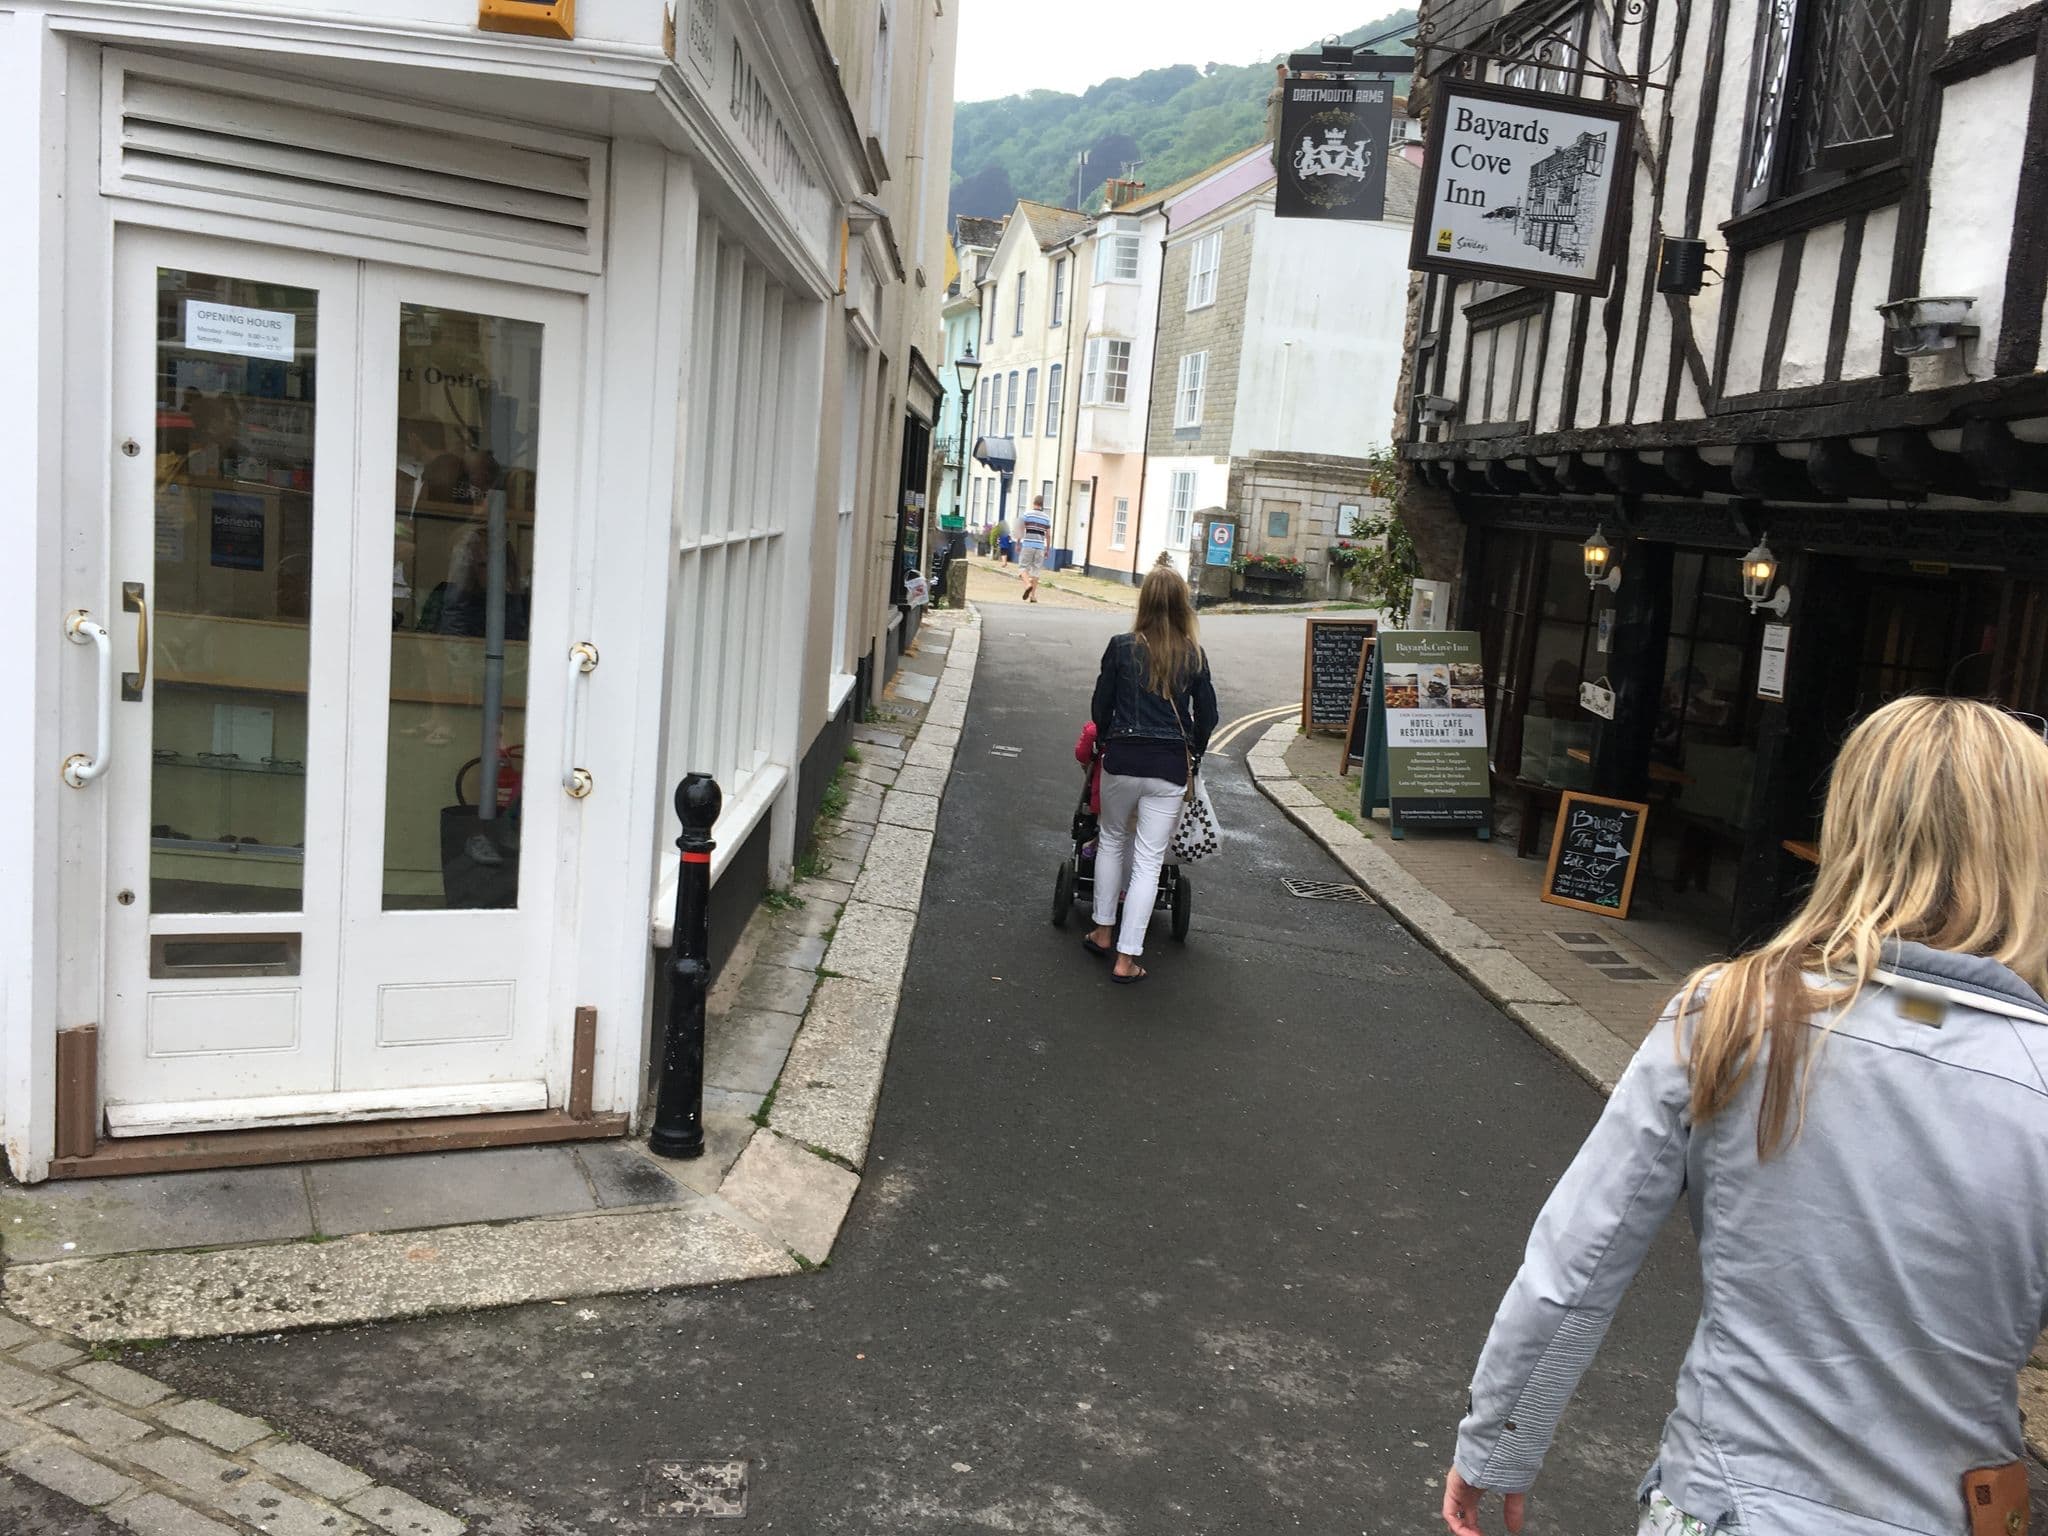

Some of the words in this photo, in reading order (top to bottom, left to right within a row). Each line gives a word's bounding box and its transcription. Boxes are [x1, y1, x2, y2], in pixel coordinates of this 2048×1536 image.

[730, 34, 773, 168] DART
[1292, 88, 1354, 103] DARTMOUTH
[1355, 89, 1385, 103] ARMS
[1454, 107, 1550, 145] Bayards
[1450, 144, 1512, 175] Cove
[1443, 178, 1486, 208] Inn
[197, 310, 244, 325] OPENING
[246, 318, 283, 330] HOURS
[214, 513, 262, 529] beneath
[1395, 642, 1431, 653] Bayards
[1431, 641, 1453, 652] Cove
[1453, 642, 1469, 652] Inn
[1400, 728, 1449, 737] RESTAURANT
[1458, 728, 1474, 737] BAR
[1410, 719, 1435, 728] HOTEL
